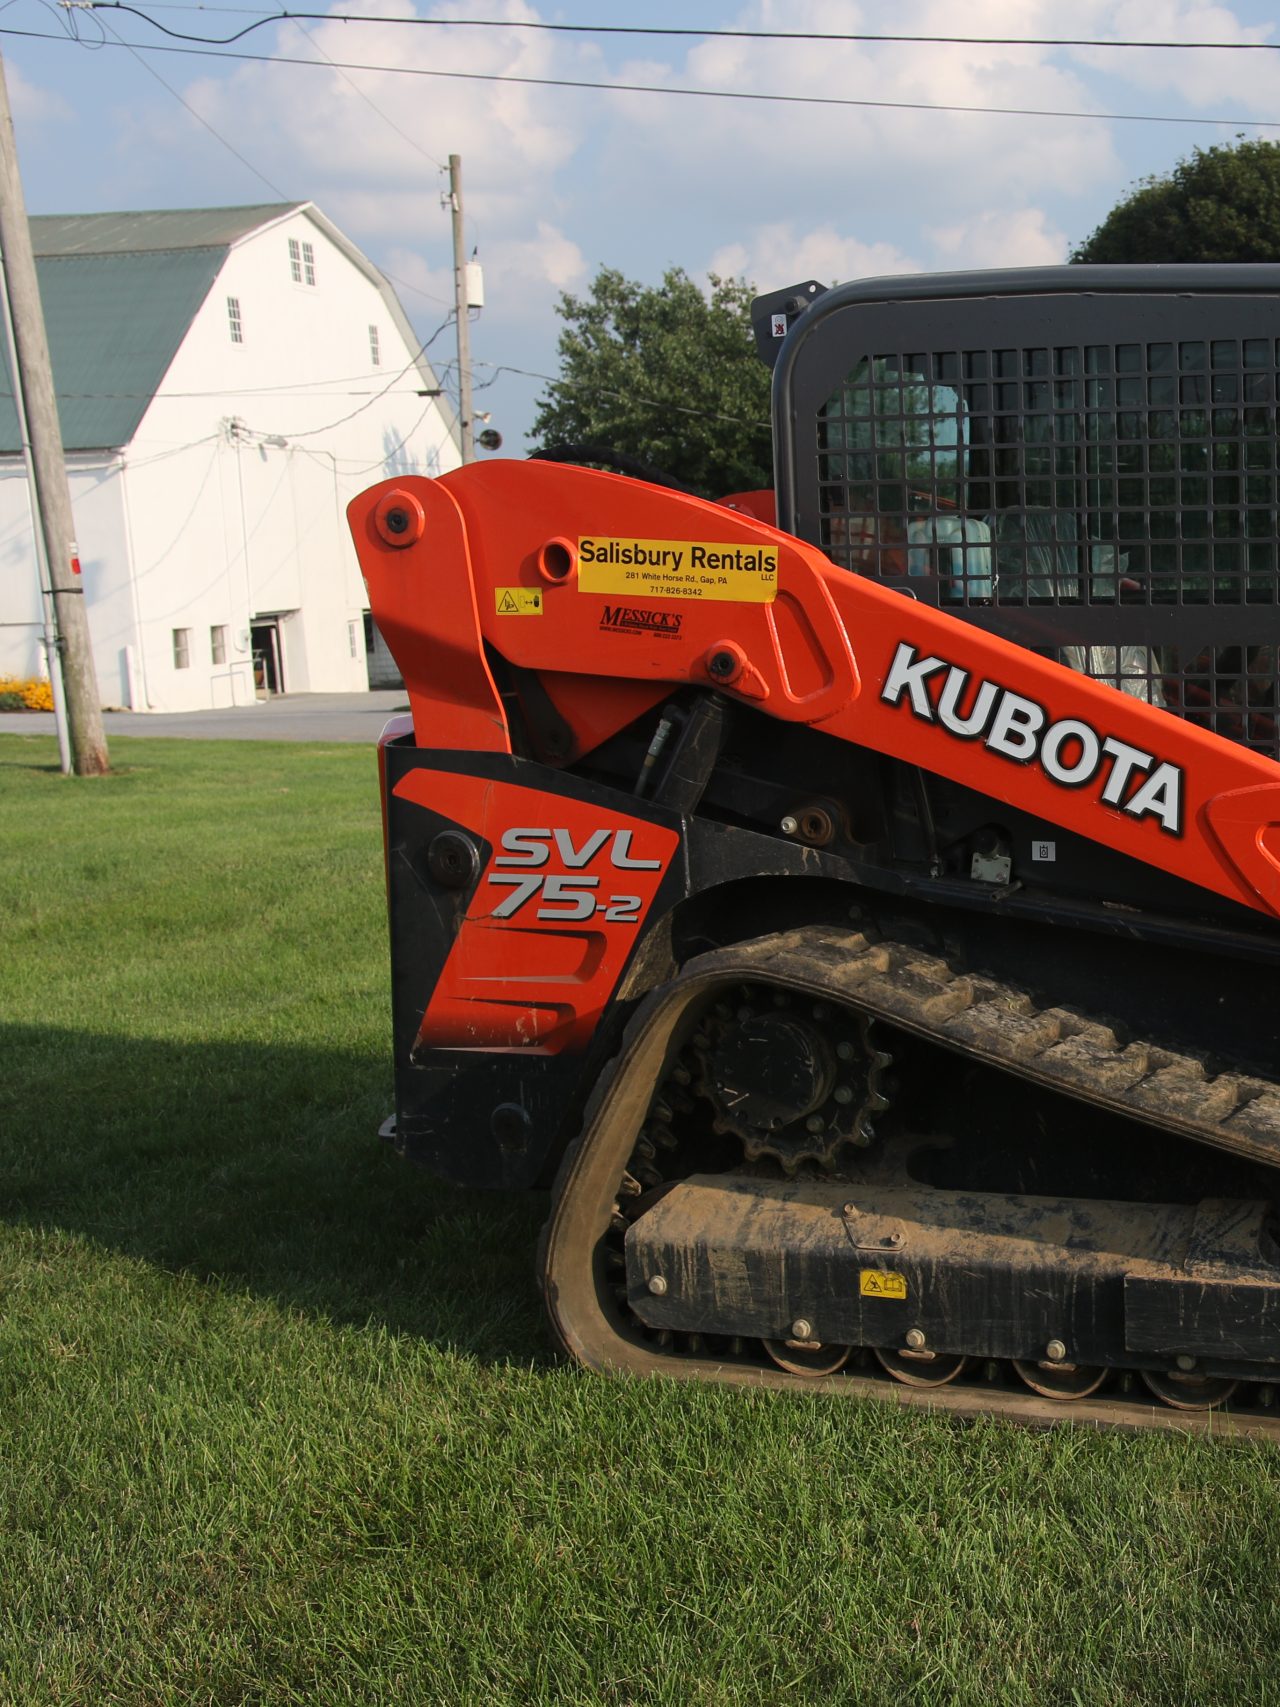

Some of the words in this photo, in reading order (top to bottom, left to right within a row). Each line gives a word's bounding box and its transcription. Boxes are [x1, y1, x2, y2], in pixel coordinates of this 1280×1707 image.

[579, 540, 683, 571] Salisbury
[691, 546, 776, 572] Rentals
[625, 571, 639, 579] 281
[641, 572, 661, 580] White
[662, 573, 683, 582] Horse
[700, 575, 716, 585] Gap,
[718, 576, 728, 584] PA
[650, 585, 703, 595] 717-826-8342
[760, 573, 775, 581] LLC
[600, 605, 683, 627] MESSICK'S
[880, 641, 1181, 834] KUBOTA
[495, 828, 662, 869] SVL
[488, 873, 642, 922] 75-2
